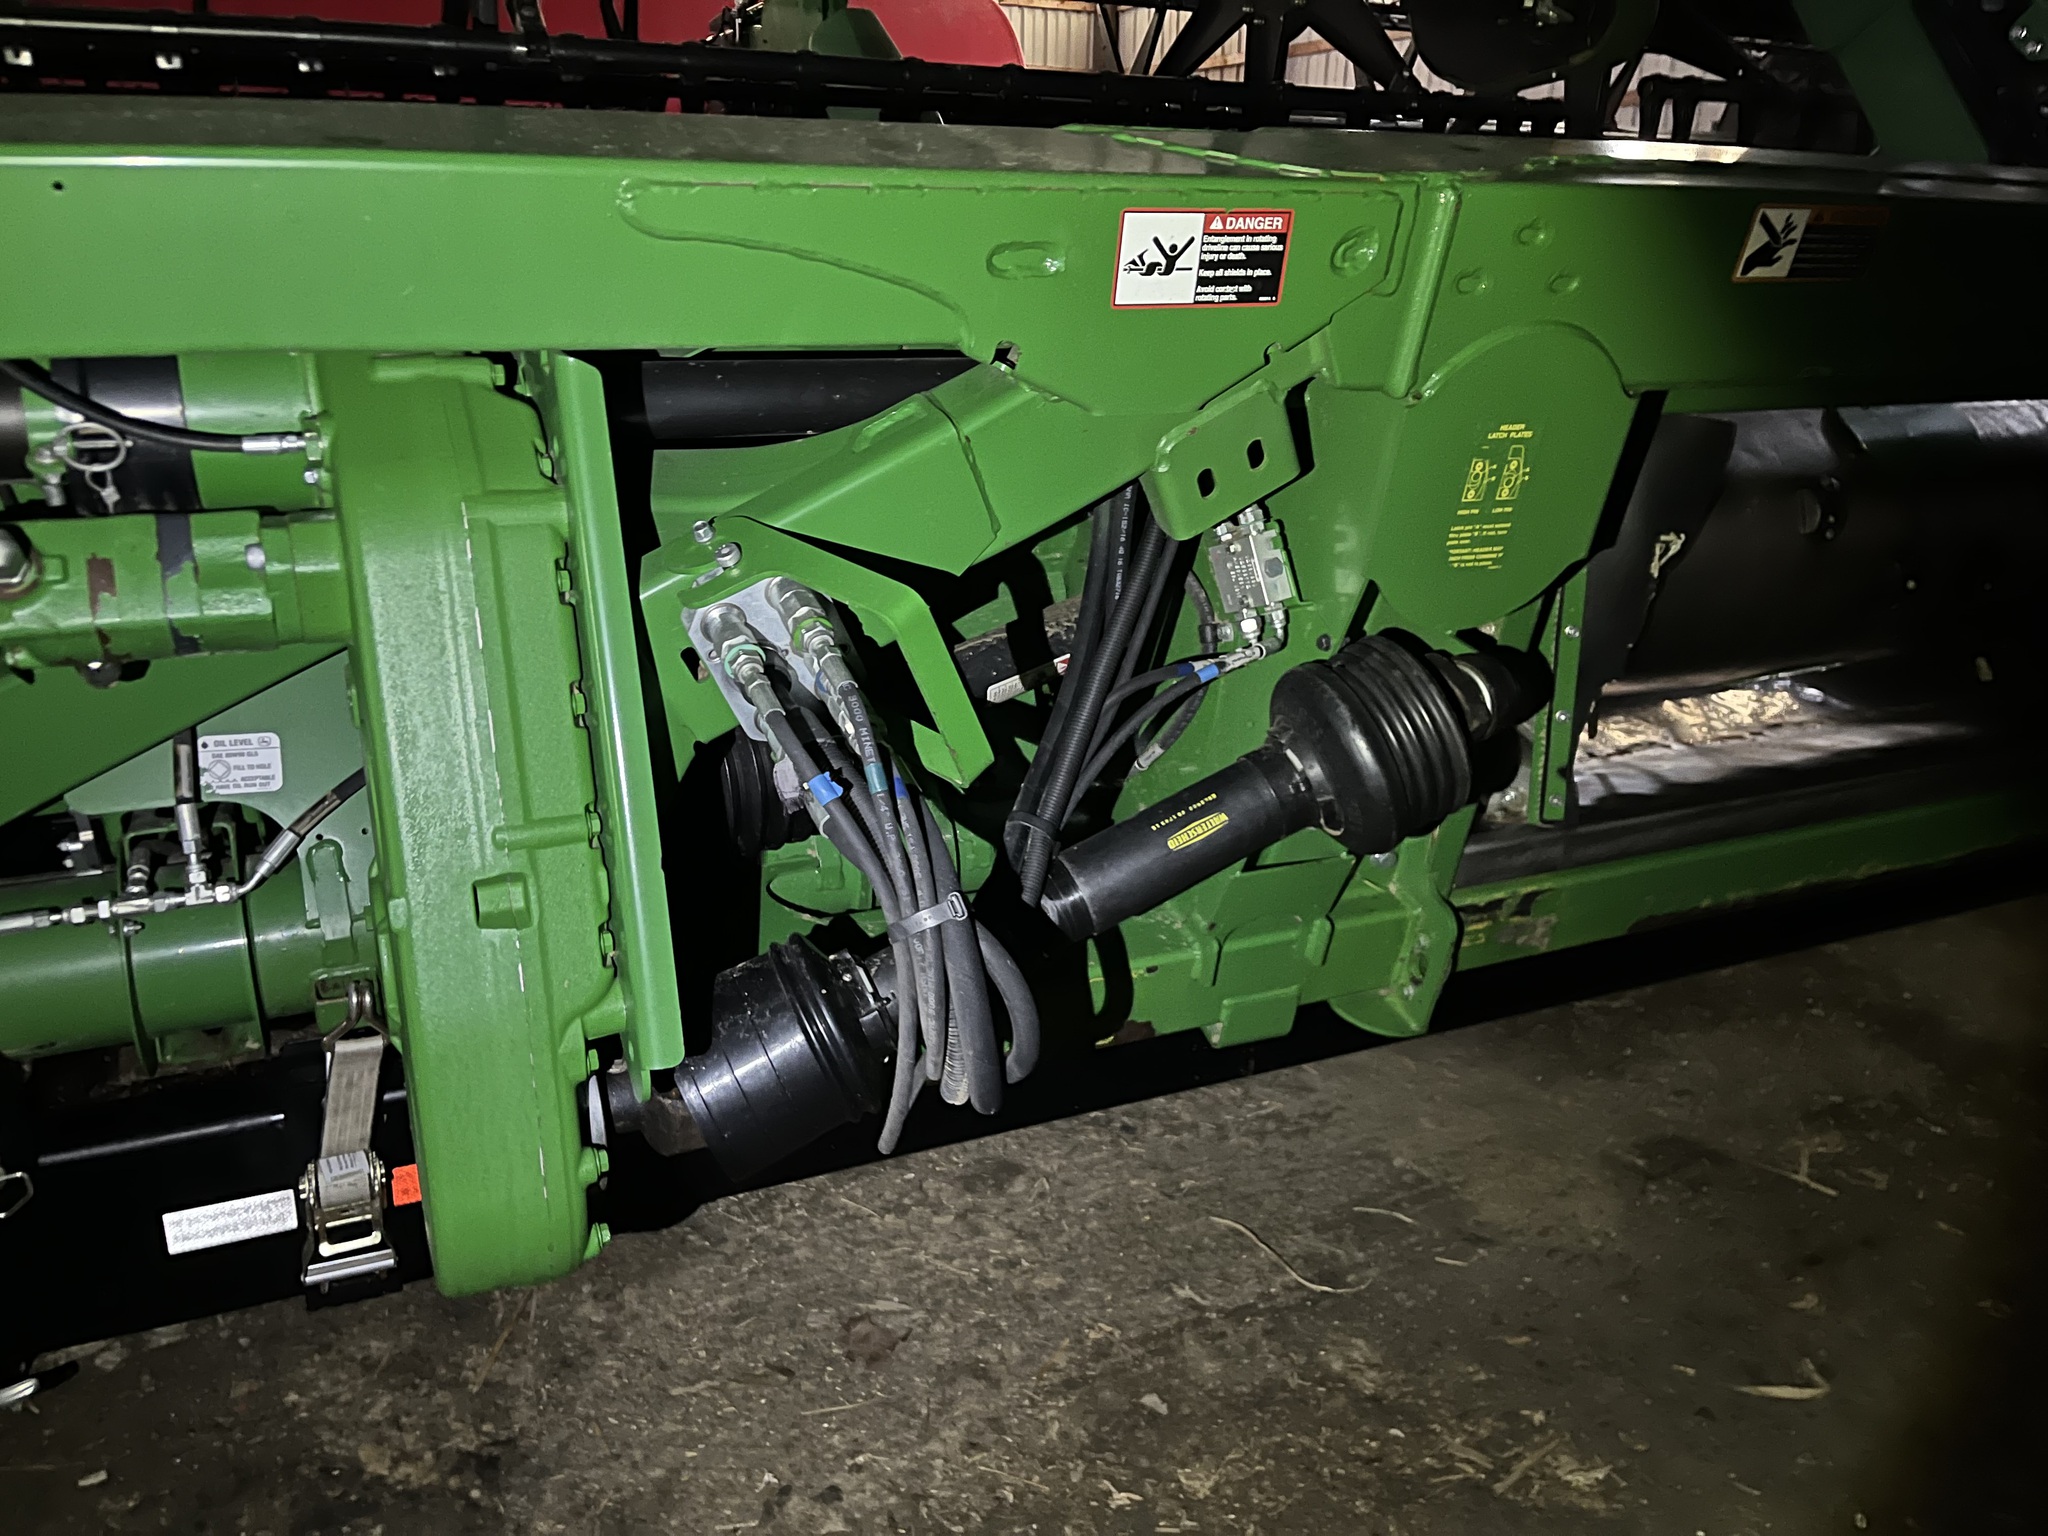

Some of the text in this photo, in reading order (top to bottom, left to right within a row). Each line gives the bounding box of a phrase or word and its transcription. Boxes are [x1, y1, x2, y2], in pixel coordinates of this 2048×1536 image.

[1225, 216, 1283, 230] DANGER
[1245, 235, 1252, 243] in
[1198, 269, 1215, 278] Keep
[1196, 285, 1215, 293] Avoid
[229, 738, 253, 746] LEVEL
[1169, 814, 1228, 849] WALTERSCHEID
